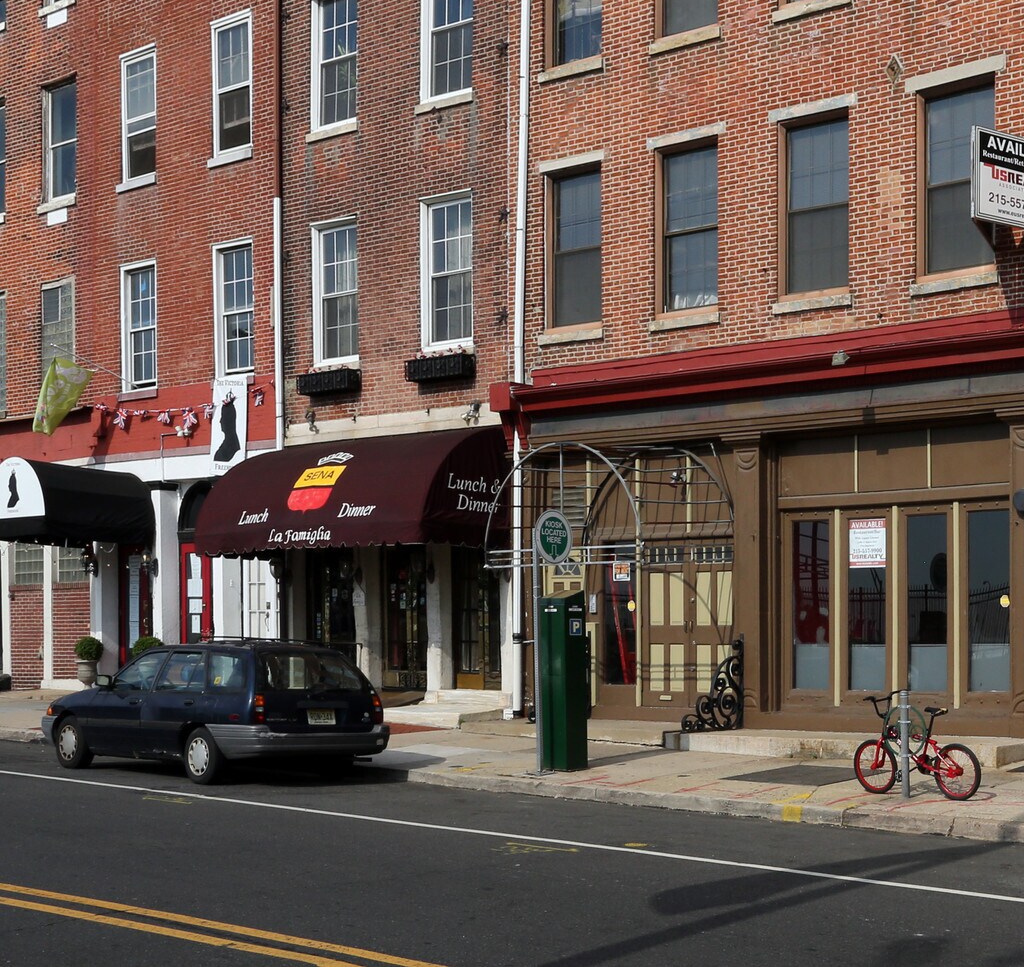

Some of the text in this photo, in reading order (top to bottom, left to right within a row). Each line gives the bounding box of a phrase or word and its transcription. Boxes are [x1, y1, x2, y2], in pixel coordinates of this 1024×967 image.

[304, 470, 334, 482] SENA
[448, 473, 501, 494] Lunch &
[337, 502, 376, 518] Dinner
[457, 493, 501, 514] Dinner
[238, 508, 269, 525] Lunch
[545, 521, 563, 530] KIOSK
[268, 525, 331, 545] La Famiglia
[541, 528, 567, 538] LOCATED
[546, 536, 562, 545] HERE
[572, 621, 580, 633] P
